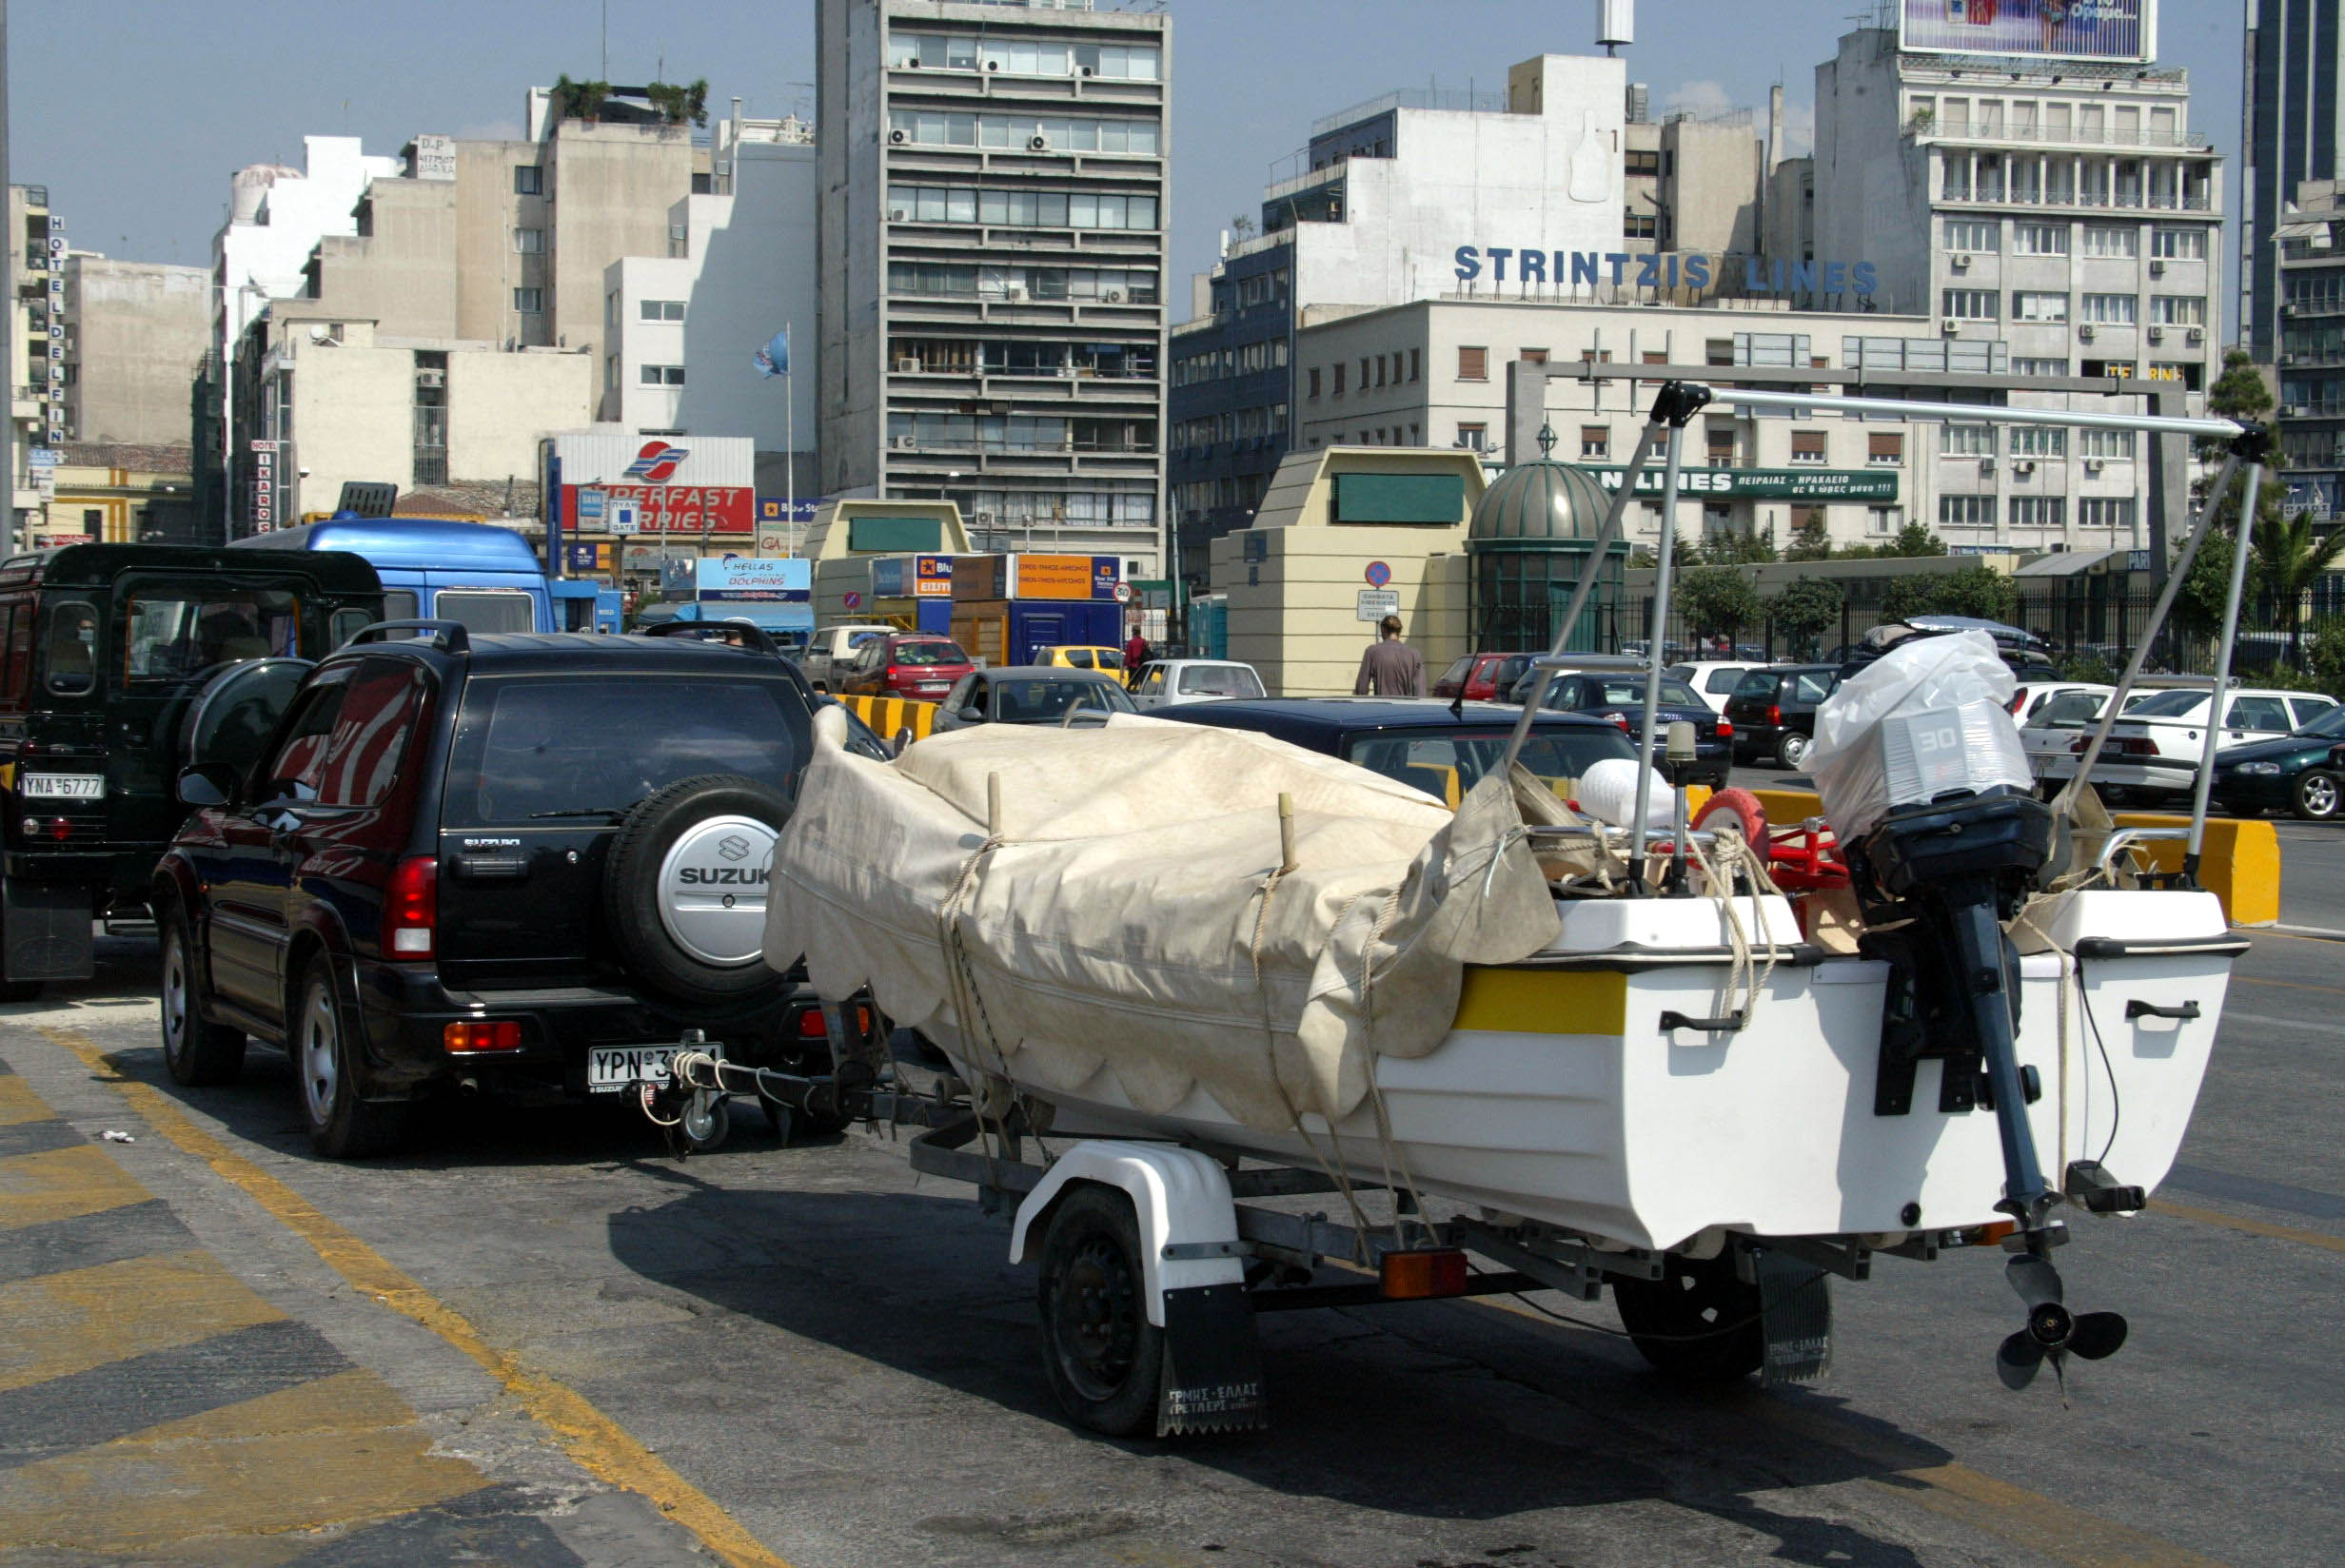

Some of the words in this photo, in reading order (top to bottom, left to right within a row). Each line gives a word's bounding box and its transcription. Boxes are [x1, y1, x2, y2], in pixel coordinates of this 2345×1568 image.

[50, 217, 63, 314] HOTEL
[1454, 245, 1710, 288] STRINTZIS
[1746, 260, 1879, 295] LINES
[50, 327, 63, 442] DELFIN
[251, 441, 277, 450] HOTEL
[1738, 476, 1787, 485] ΠΕΙΡΑΙΑΣ
[1798, 475, 1850, 484] ΗΡΑΚΛΕΙΟ
[260, 455, 269, 533] IKAROS
[607, 487, 739, 507] PERFAST
[640, 511, 718, 530] RRIES
[733, 562, 775, 571] HELLAS
[936, 562, 953, 573] Blu
[729, 578, 785, 586] DOLPHINS
[1116, 587, 1129, 597] 30
[1918, 727, 1958, 753] 30
[464, 838, 521, 848] SUZUKI
[680, 867, 772, 885] SUZUK
